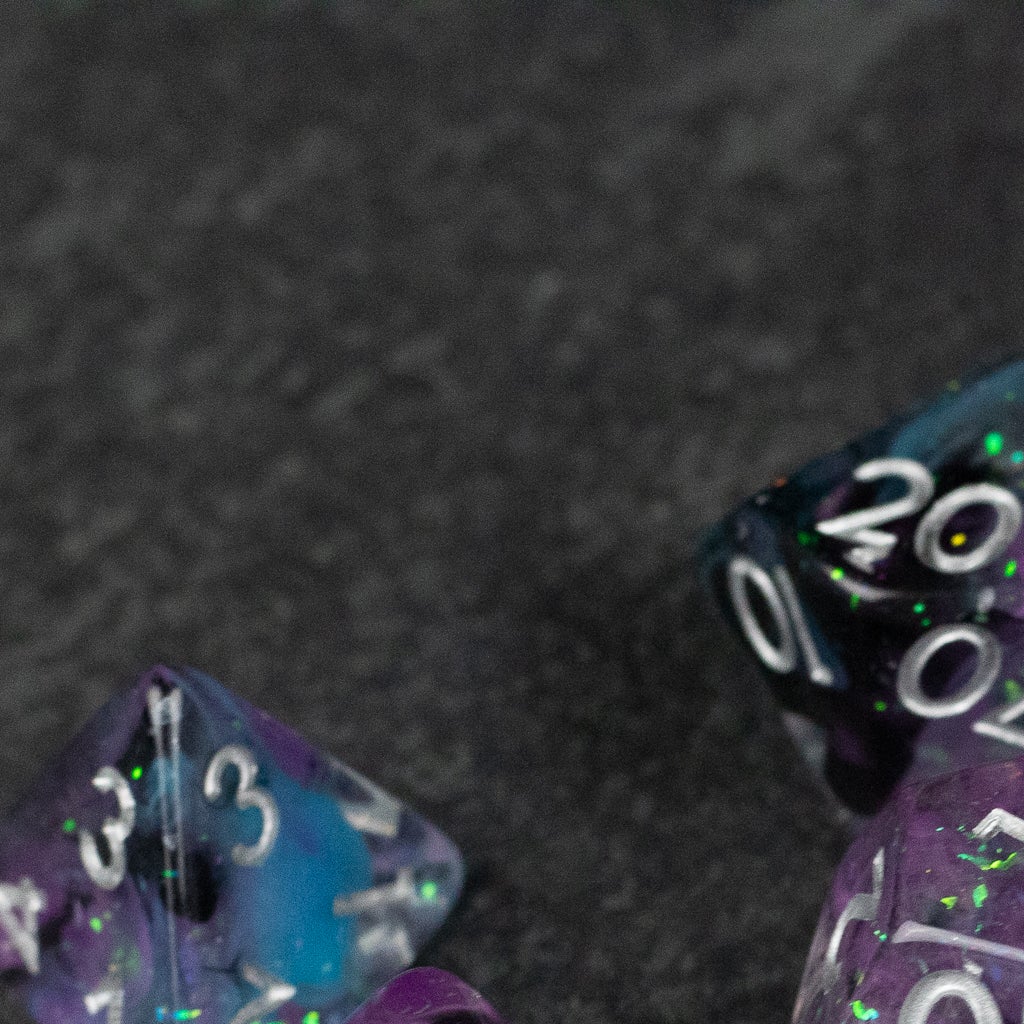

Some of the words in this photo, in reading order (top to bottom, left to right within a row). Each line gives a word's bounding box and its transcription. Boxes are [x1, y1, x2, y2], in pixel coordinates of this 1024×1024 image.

[817, 457, 1023, 574] 20
[78, 765, 136, 891] 3
[203, 744, 280, 868] 3
